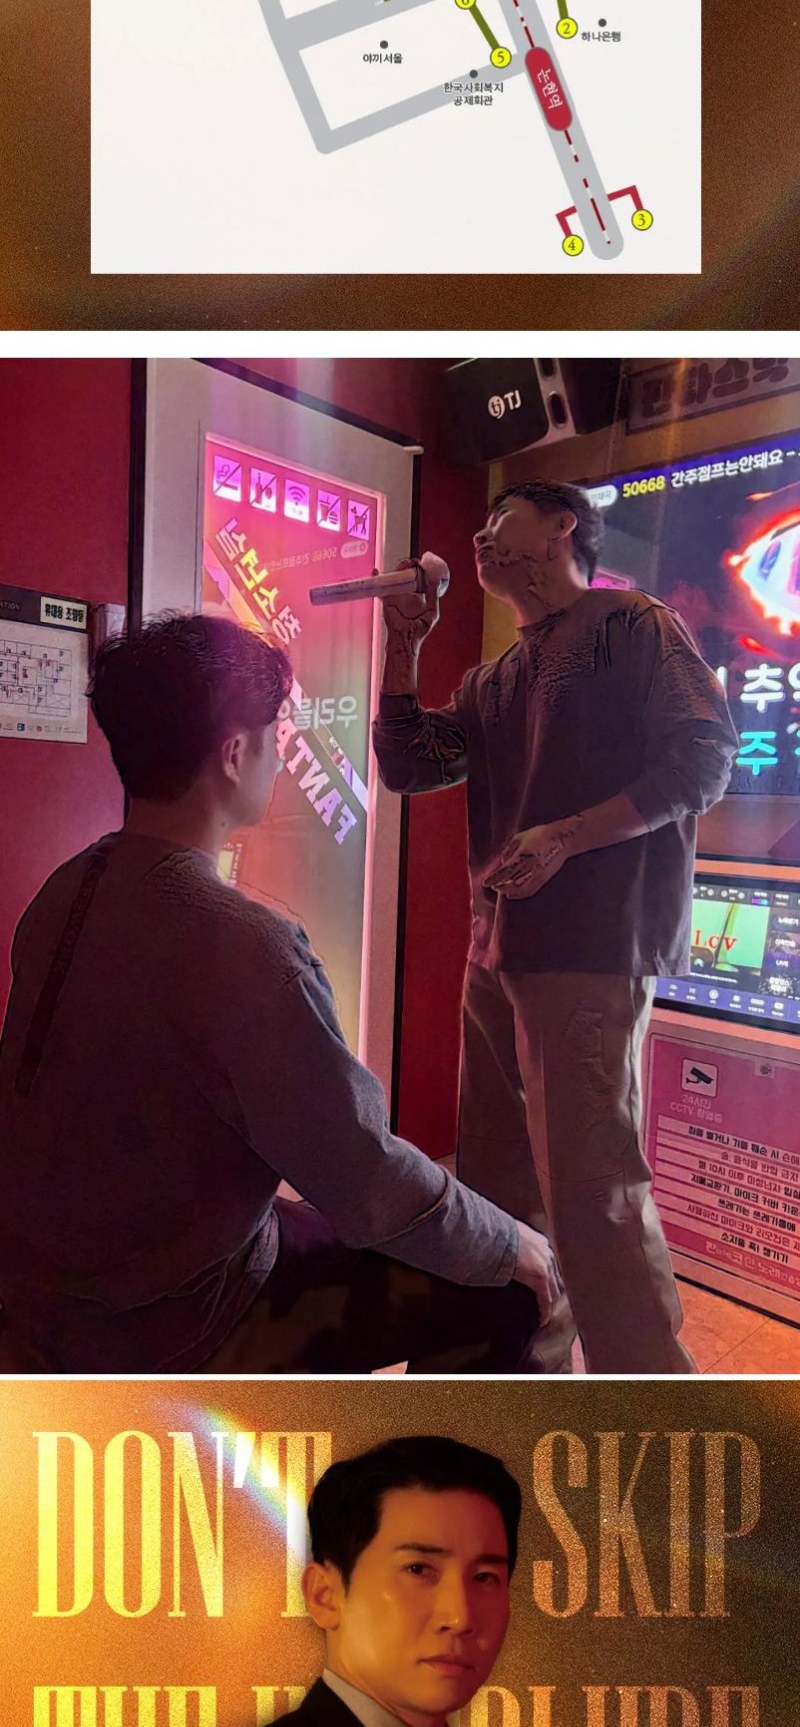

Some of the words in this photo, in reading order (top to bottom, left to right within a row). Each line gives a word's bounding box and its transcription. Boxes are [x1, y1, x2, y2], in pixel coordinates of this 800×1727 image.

[581, 31, 621, 42] 하나은행
[444, 82, 504, 93] 한국사회복지
[537, 68, 563, 109] 논현역
[454, 95, 493, 106] 공제회관
[504, 389, 522, 410] TJ
[622, 475, 666, 498] 50668
[770, 1149, 779, 1159] 시
[734, 1188, 759, 1202] 마이크
[32, 1430, 332, 1618] DON'T
[532, 1430, 761, 1618] SKIP
